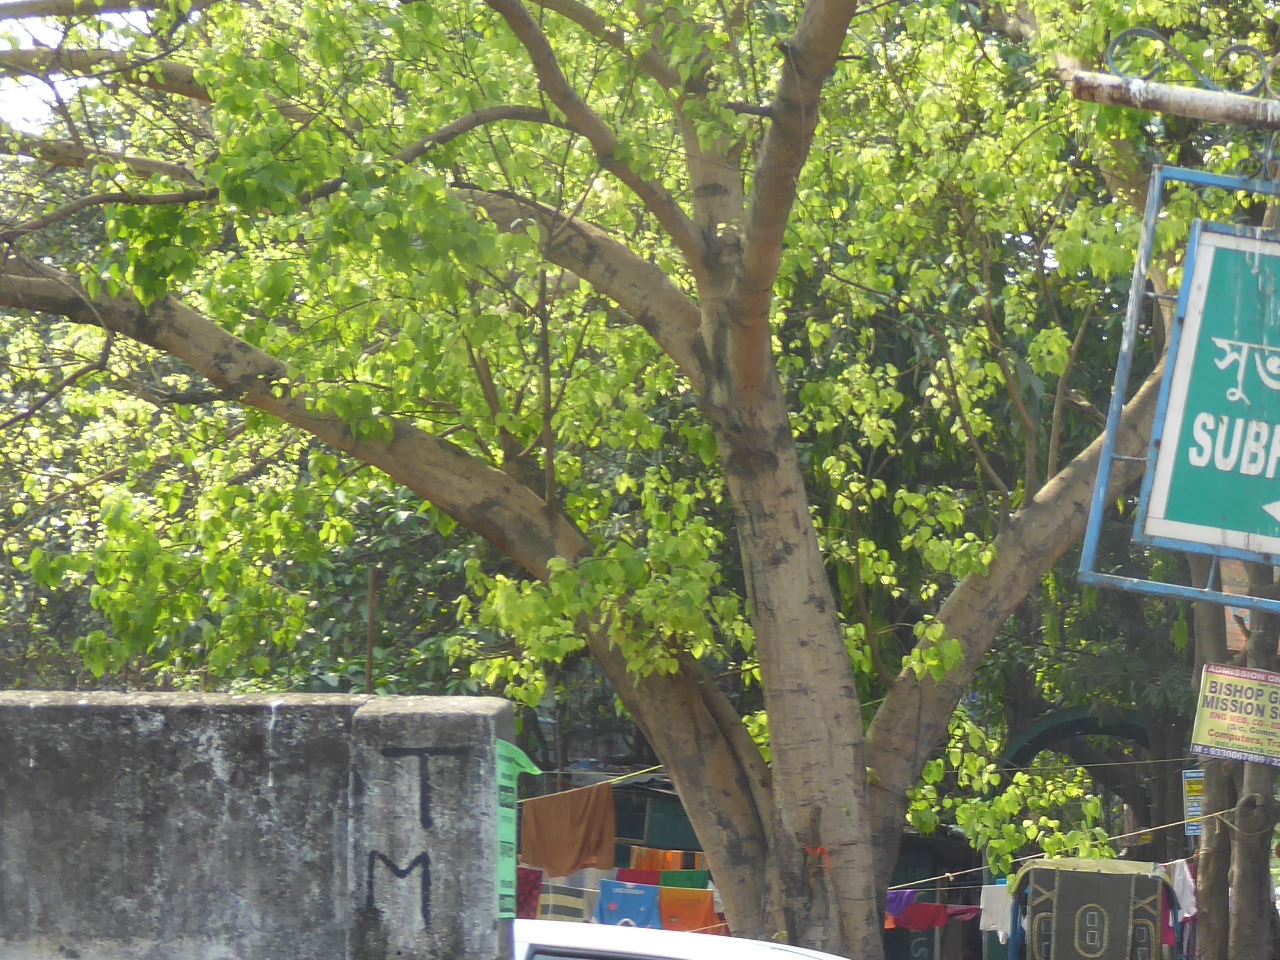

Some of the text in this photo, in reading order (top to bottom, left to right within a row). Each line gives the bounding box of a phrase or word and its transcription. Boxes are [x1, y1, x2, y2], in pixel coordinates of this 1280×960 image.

[1207, 665, 1265, 680] ADMISSION
[1209, 680, 1264, 701] BISHOP
[1202, 694, 1265, 718] MISSION
[1207, 728, 1263, 745] Computers,
